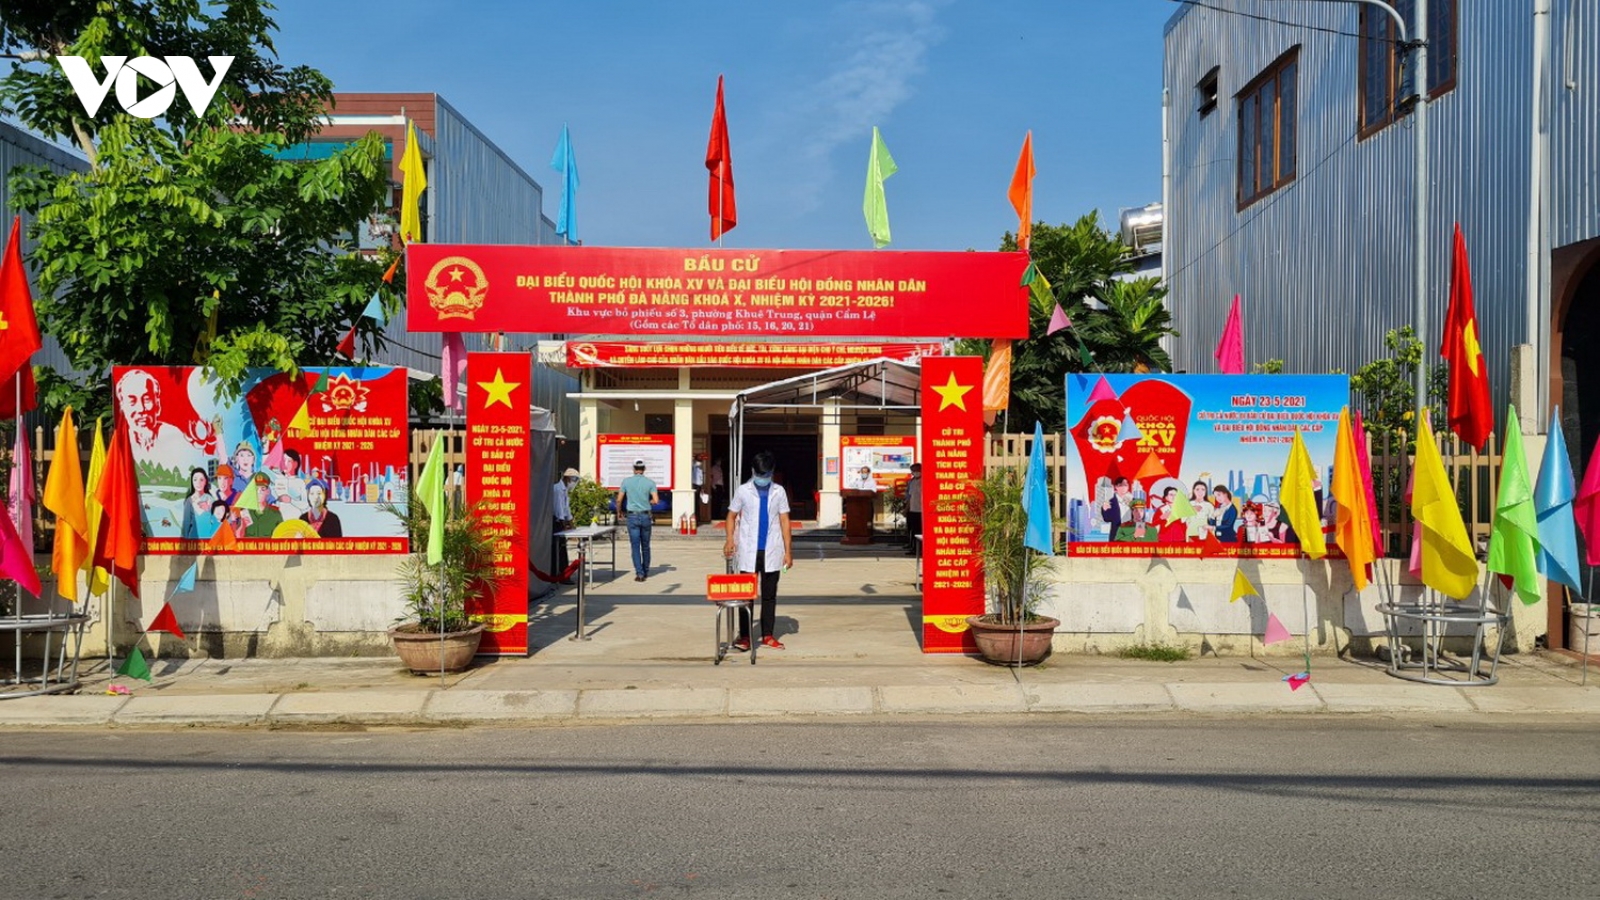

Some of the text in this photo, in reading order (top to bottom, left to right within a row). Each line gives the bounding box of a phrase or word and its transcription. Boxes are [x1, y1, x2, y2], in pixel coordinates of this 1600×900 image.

[684, 253, 760, 272] BẦU CỬ
[516, 275, 540, 290] ĐẠI
[544, 272, 575, 288] BIỂU
[579, 273, 615, 289] QUỐC
[619, 275, 642, 291] HỘI
[646, 276, 683, 289] KHÓA
[686, 278, 704, 290] XV
[707, 277, 725, 290] VÀ
[728, 278, 751, 292] ĐẠI
[755, 275, 786, 290] BIỂU
[789, 277, 812, 293] HỘI
[857, 278, 895, 292] NHÂN
[898, 278, 926, 292] DÂN
[549, 290, 594, 303] THÀNH
[598, 289, 626, 304] PHỐ
[629, 291, 648, 305] ĐÀ
[734, 294, 747, 307] X,
[751, 293, 795, 308] NHIỆM
[798, 293, 815, 307] KỲ
[819, 295, 895, 308] 2021-2026!
[1231, 394, 1257, 407] NGÀY
[1136, 429, 1176, 447] XV
